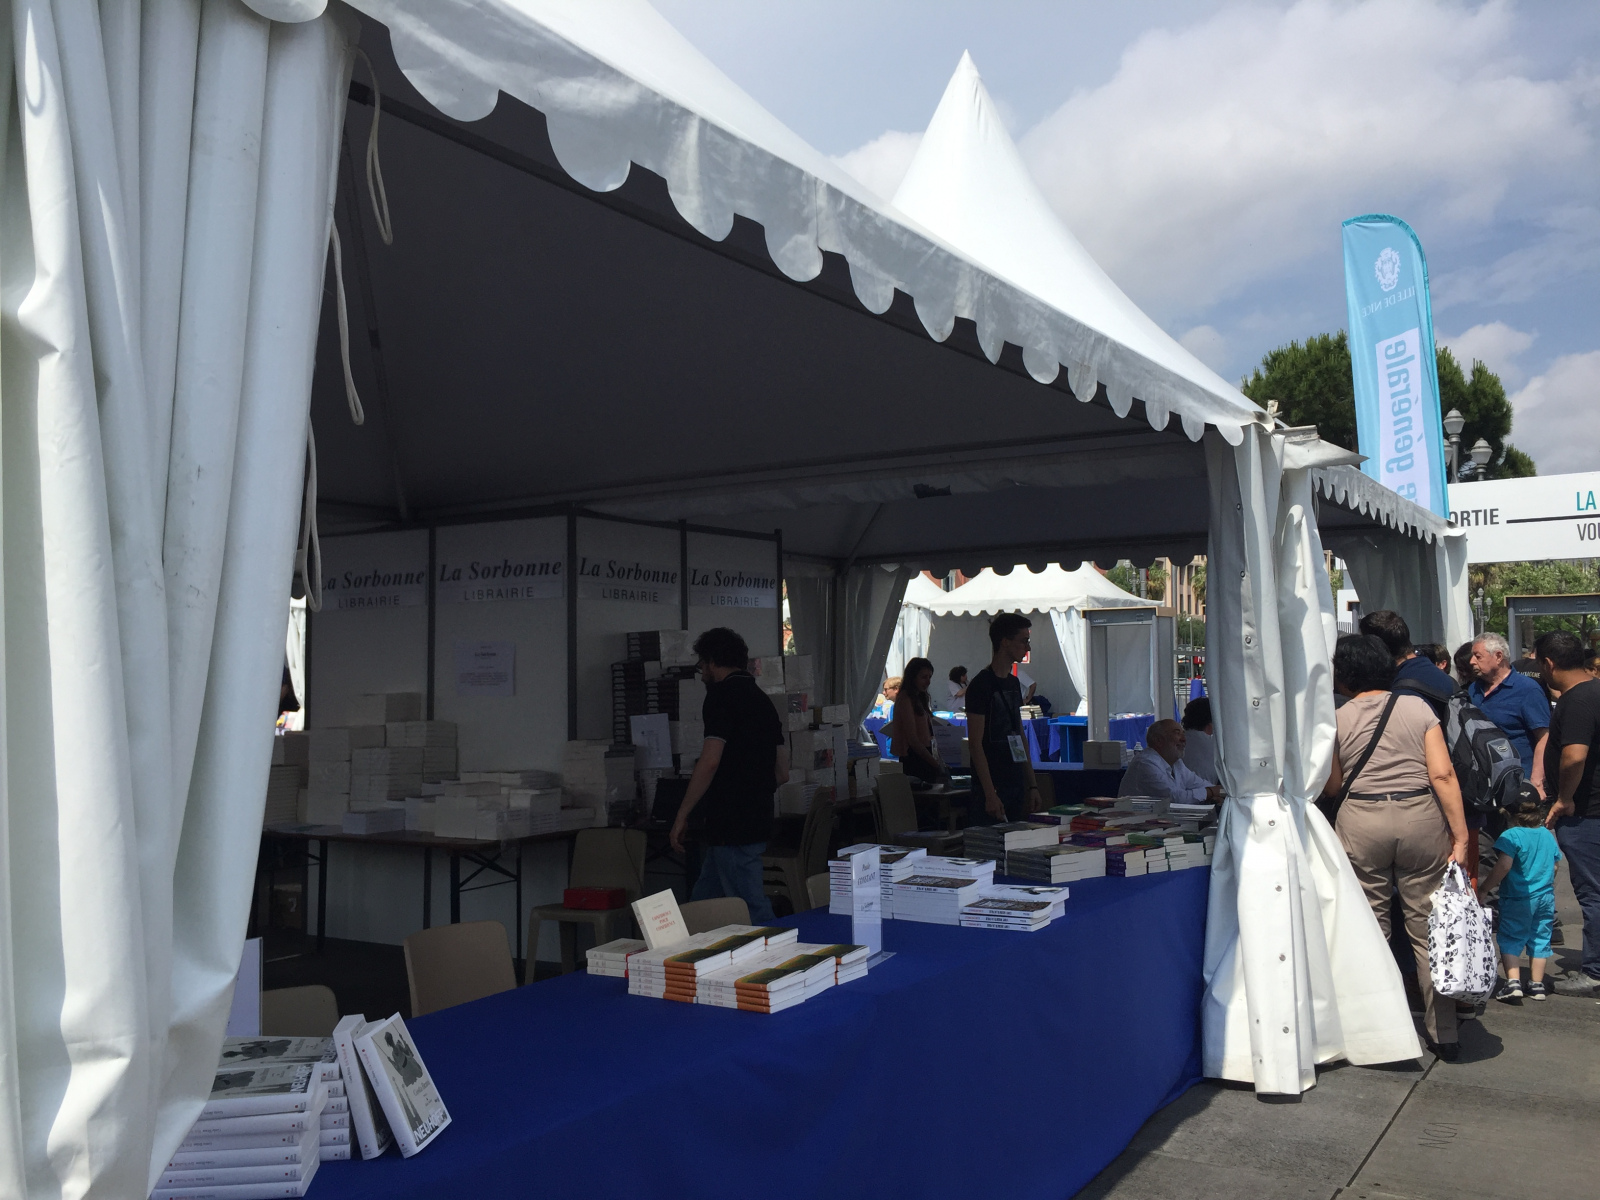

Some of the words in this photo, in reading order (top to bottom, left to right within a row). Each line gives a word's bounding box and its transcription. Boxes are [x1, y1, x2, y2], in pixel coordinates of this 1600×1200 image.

[1576, 490, 1597, 511] LA
[1449, 508, 1499, 527] ORTIE
[1577, 522, 1600, 541] VO
[342, 569, 425, 589] Sorbonne
[439, 564, 462, 582] La
[469, 559, 562, 580] Sorbonne
[579, 557, 601, 577] La
[606, 559, 678, 585] Sorbonne
[691, 568, 709, 586] La
[713, 569, 776, 589] Sorbonne
[338, 595, 400, 609] LIBRAIRIE
[464, 586, 535, 601] LIBRAIRIE
[602, 588, 659, 603] LIBRAIRIE
[710, 595, 760, 607] LIBRAIRIE
